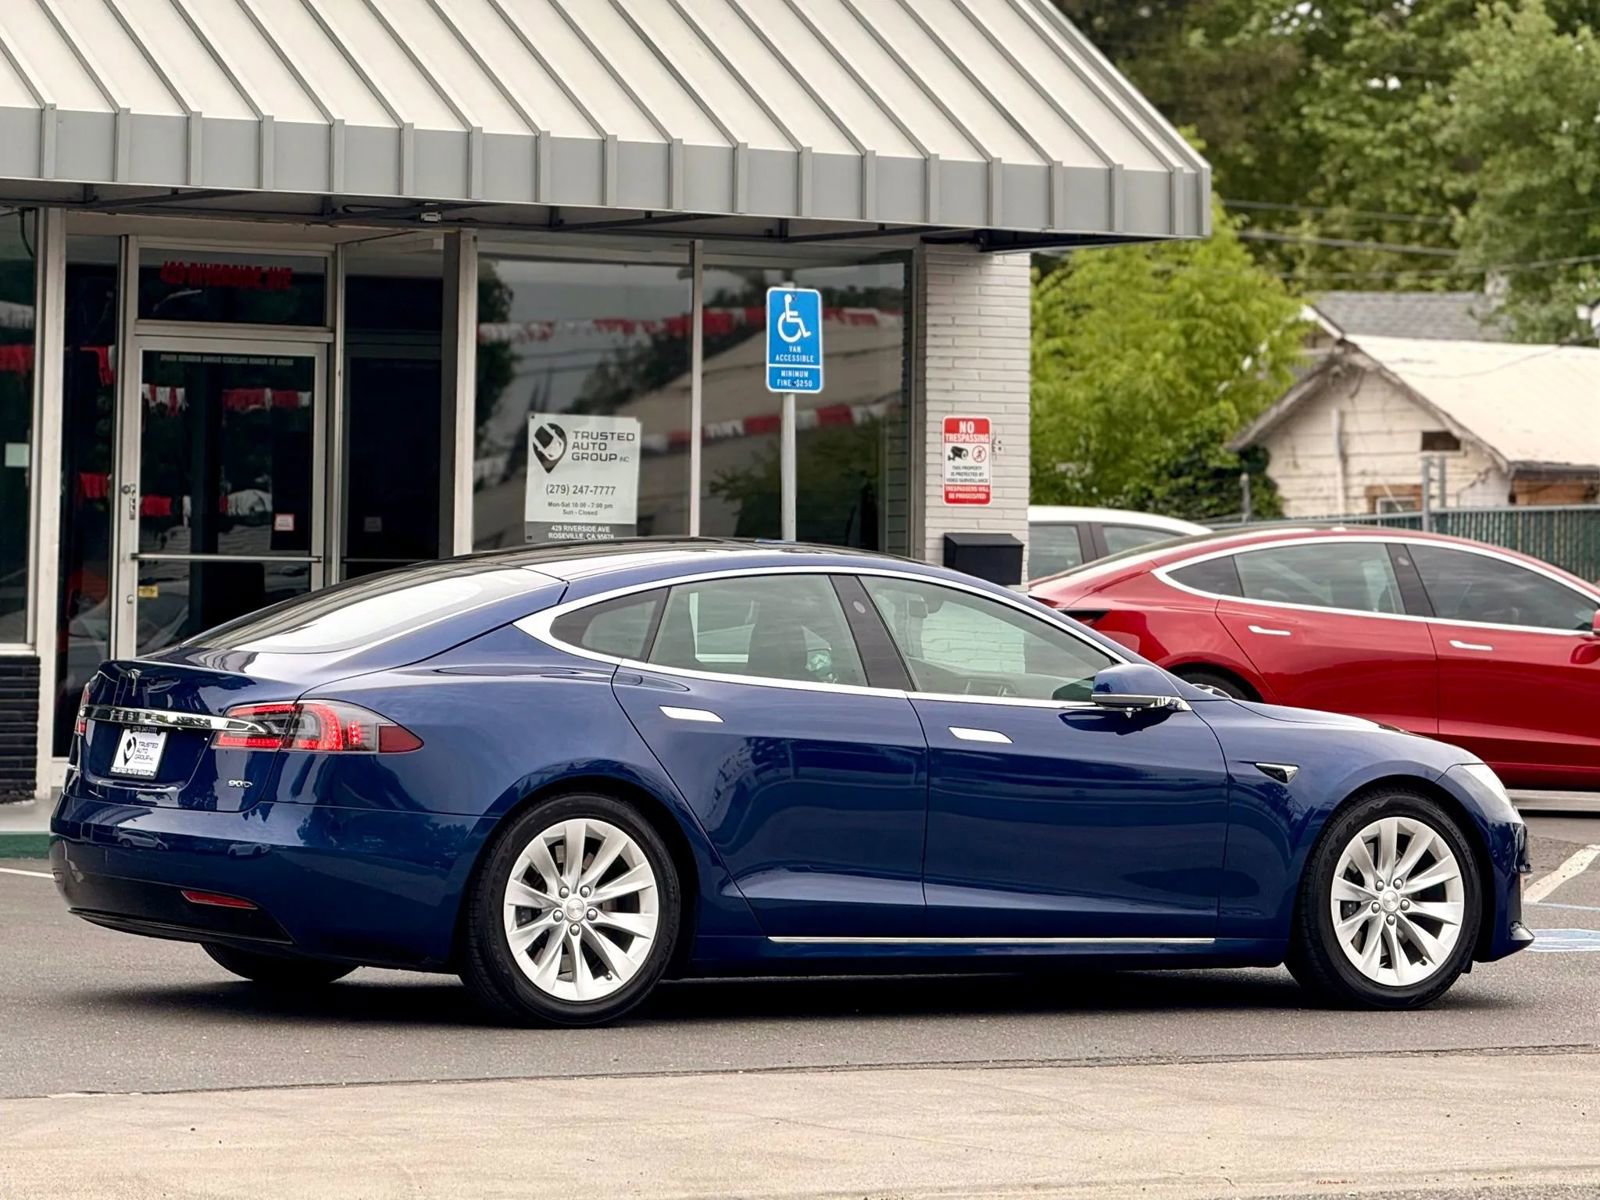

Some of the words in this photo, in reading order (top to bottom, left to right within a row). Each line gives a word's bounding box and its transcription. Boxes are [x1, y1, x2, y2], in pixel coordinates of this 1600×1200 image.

[775, 354, 814, 363] ACCESSIBLE
[781, 370, 809, 378] MINIMUM
[777, 379, 792, 387] FINE
[796, 379, 813, 388] $250
[959, 420, 975, 434] NO
[573, 430, 635, 441] TRUSTED
[945, 433, 989, 442] TRESPASSING
[571, 442, 607, 451] AUTO
[571, 452, 618, 462] GROUP
[545, 483, 570, 496] (279)
[572, 484, 616, 496] 247-7777
[563, 525, 596, 533] RIVERSIDE
